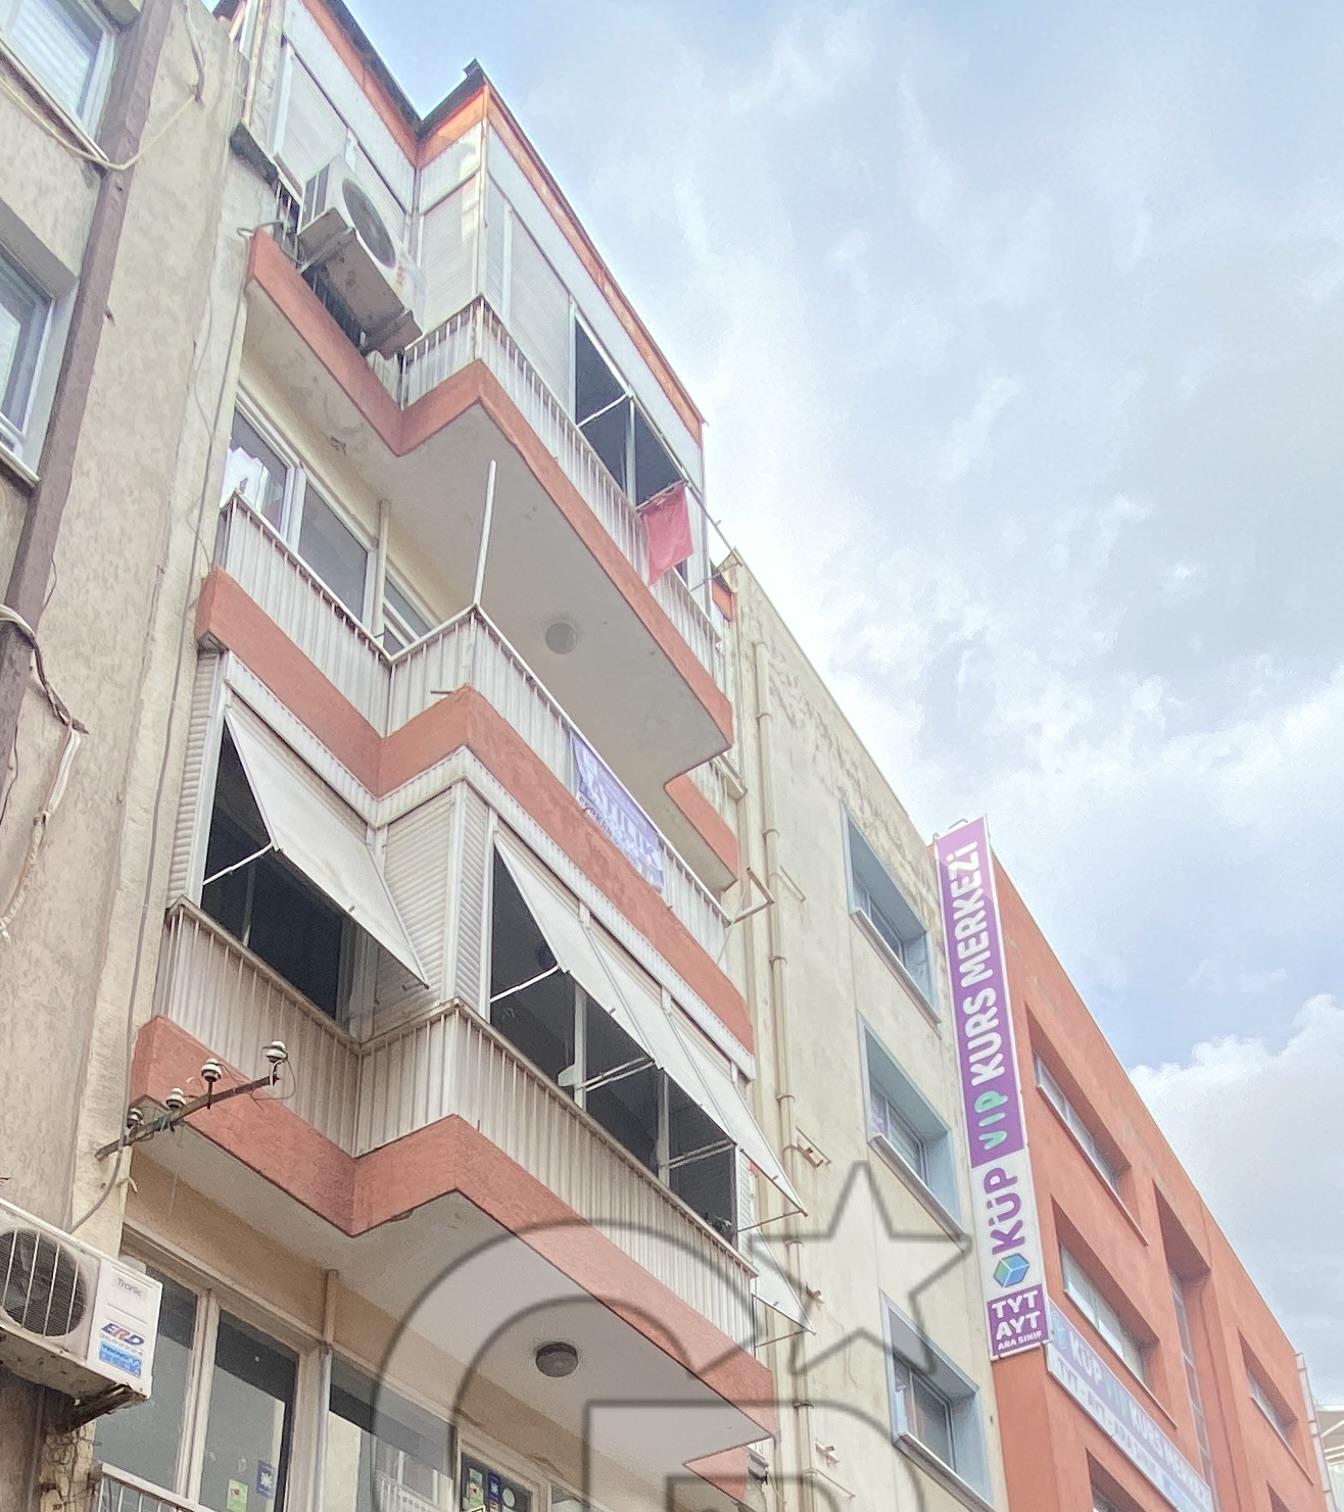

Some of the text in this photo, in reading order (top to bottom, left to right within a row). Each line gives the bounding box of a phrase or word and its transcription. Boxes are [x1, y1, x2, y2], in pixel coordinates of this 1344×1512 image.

[949, 839, 992, 989] MERKEZİ
[969, 993, 1005, 1088] KURS
[987, 1165, 1026, 1256] KÜP
[991, 1288, 1039, 1320] TYT
[995, 1311, 1042, 1342] AYT
